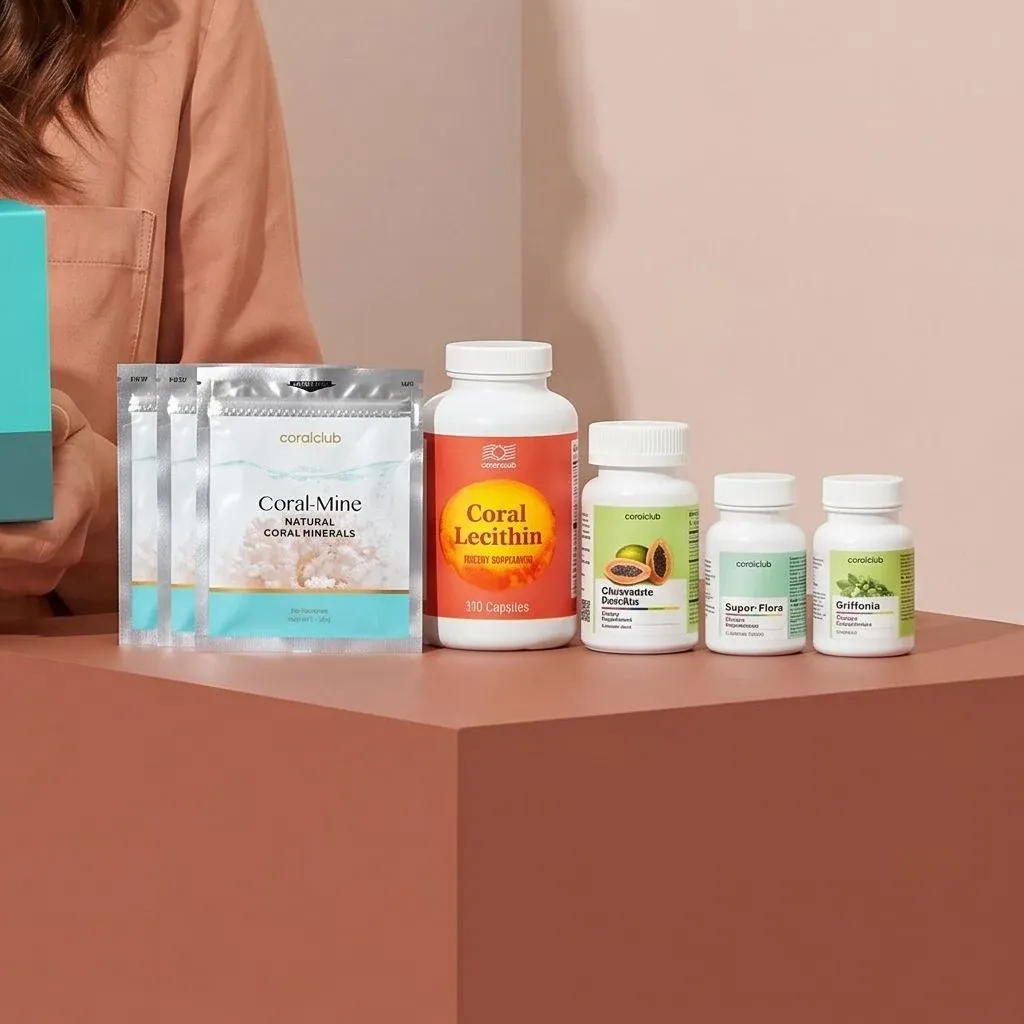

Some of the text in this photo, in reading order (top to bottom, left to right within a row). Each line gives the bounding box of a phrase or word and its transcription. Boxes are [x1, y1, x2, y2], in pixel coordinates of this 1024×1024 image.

[279, 432, 342, 444] coralclub
[258, 494, 363, 512] Coral-Mine
[466, 503, 527, 523] Coral
[285, 517, 335, 527] NATURAL
[263, 528, 356, 538] CORAL MINERALS
[454, 526, 543, 546] Lecithin
[836, 600, 881, 611] Griffonia
